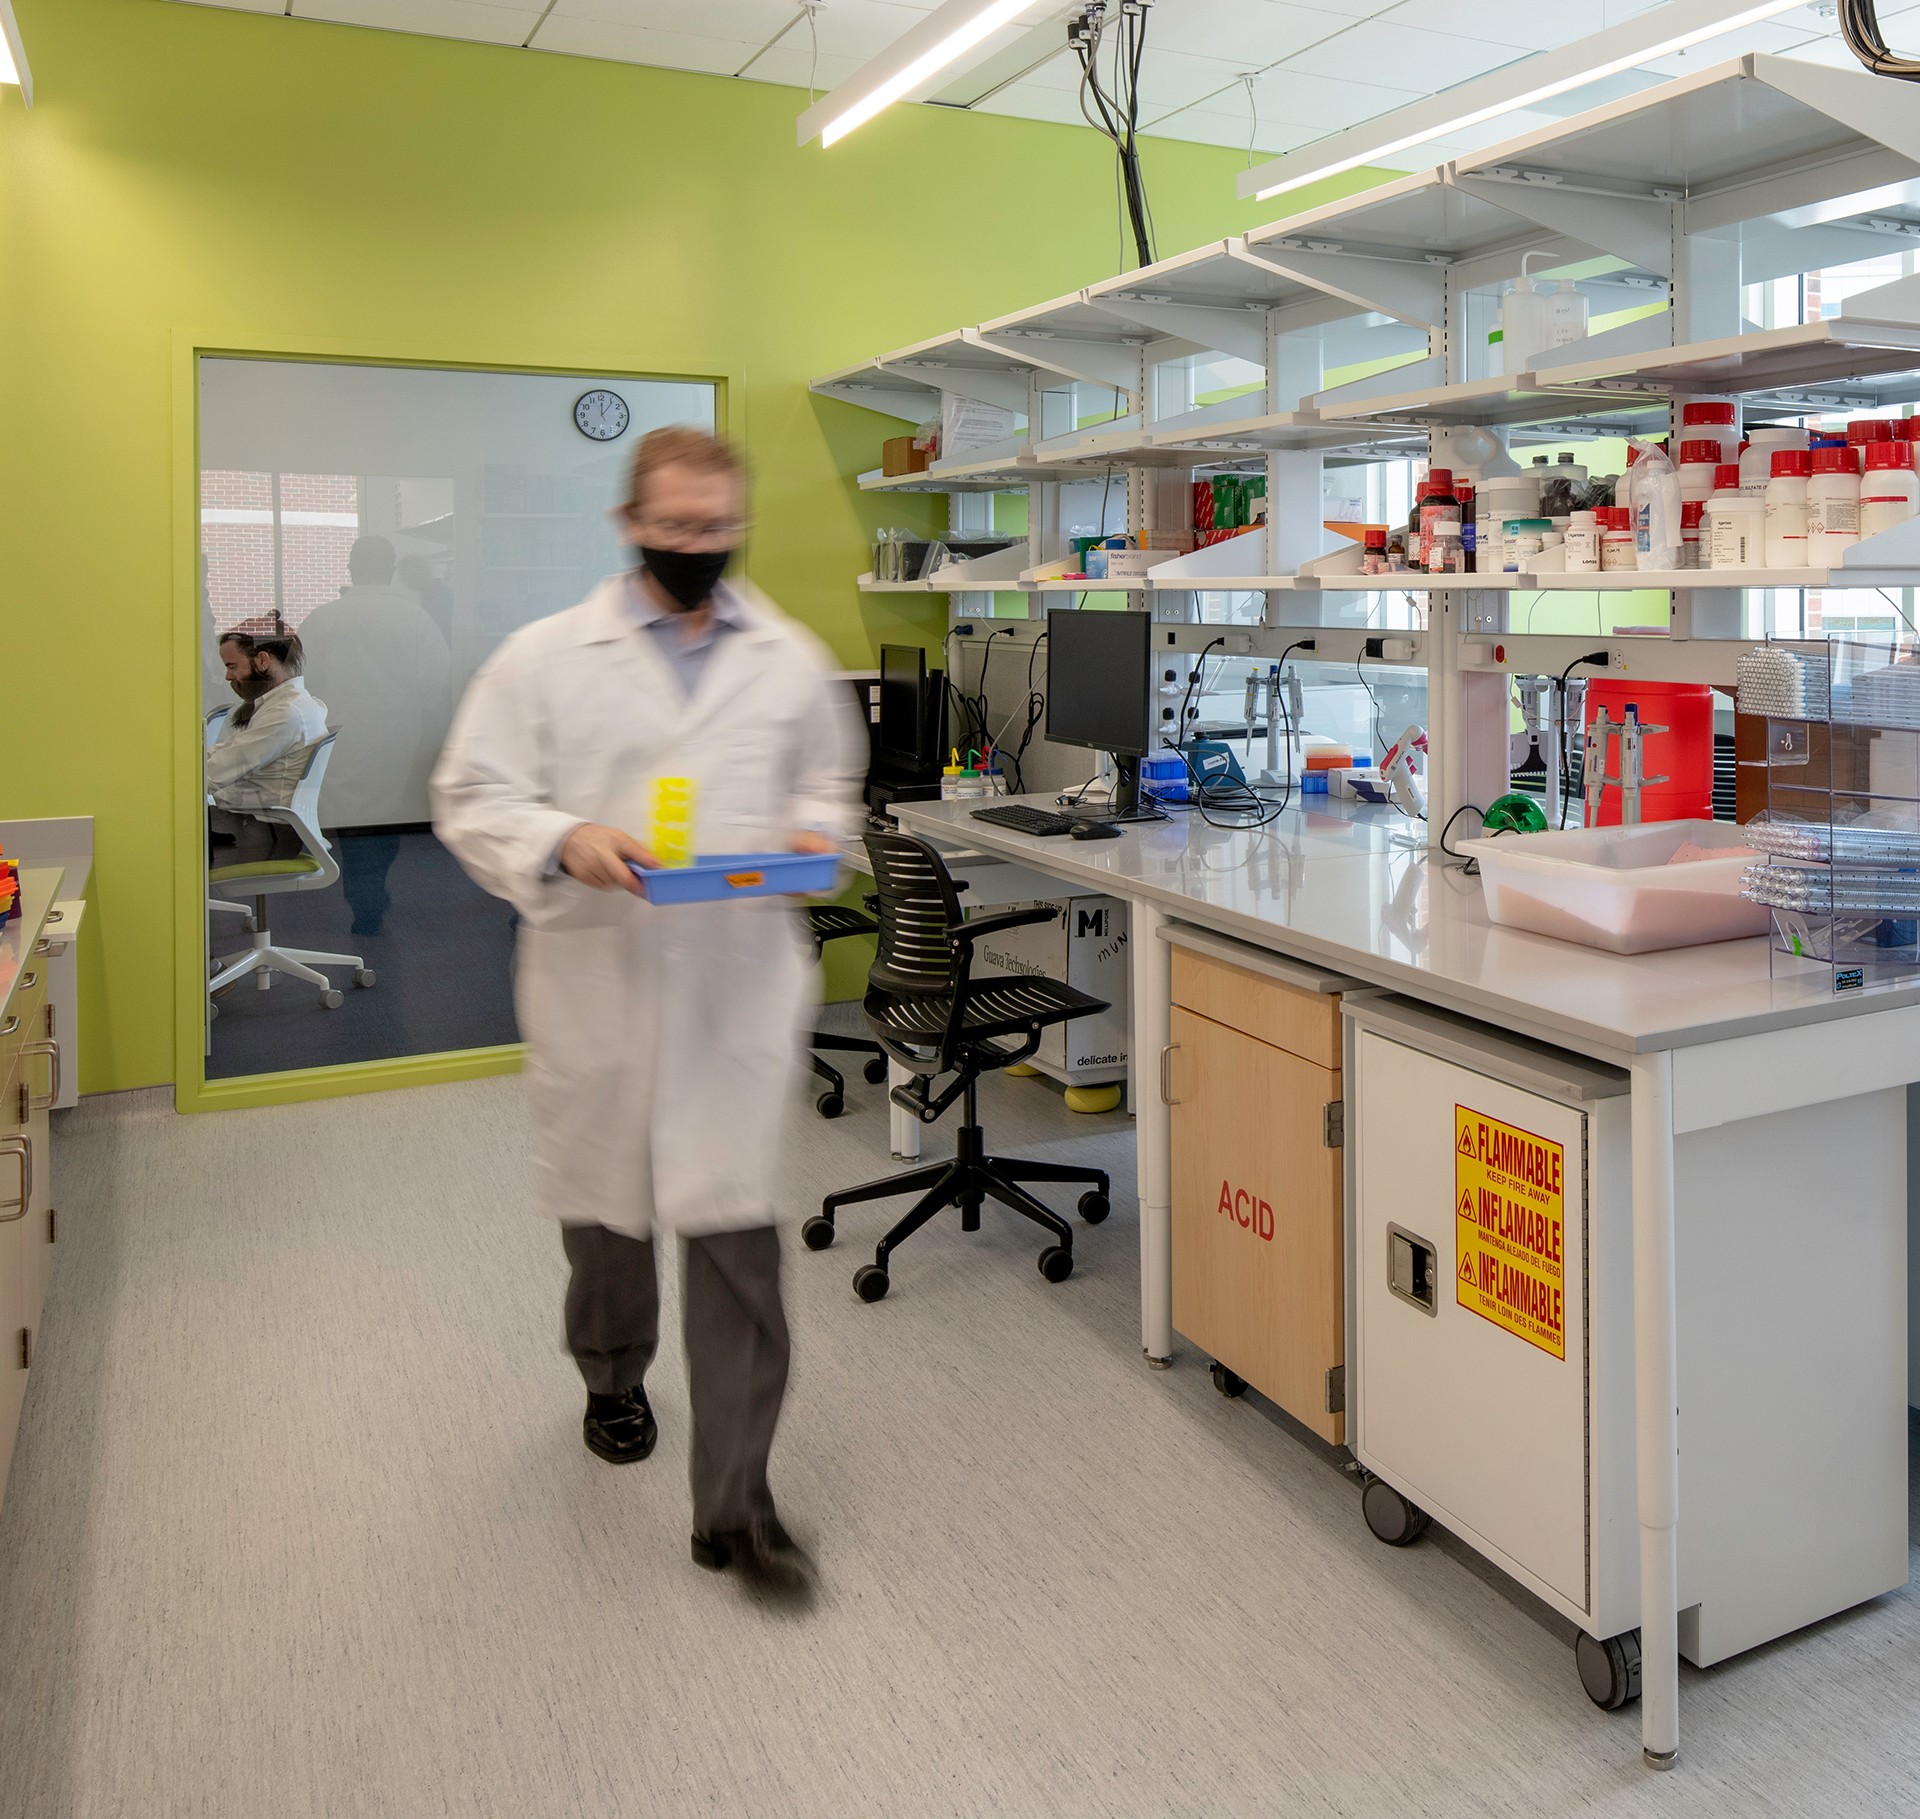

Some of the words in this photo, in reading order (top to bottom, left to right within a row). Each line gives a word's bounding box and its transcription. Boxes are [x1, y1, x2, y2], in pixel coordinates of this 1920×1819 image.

[1078, 909, 1103, 937] M
[984, 945, 1004, 968] Guava
[1077, 1054, 1118, 1066] delicate
[1478, 1123, 1560, 1195] FLAMMABLE
[1218, 1180, 1274, 1241] ACID
[1486, 1169, 1506, 1186] KEEP
[1508, 1179, 1526, 1195] FIRE
[1528, 1187, 1550, 1206] AWAY
[1478, 1187, 1560, 1264] INFLAMABLE
[1478, 1230, 1506, 1251] MANTENGA
[1506, 1241, 1530, 1263] ALEJADO
[1530, 1252, 1541, 1268] DEL
[1542, 1258, 1560, 1278] FUEGO
[1478, 1250, 1561, 1332] INFLAMMABLE
[1478, 1294, 1497, 1311] TENIR
[1498, 1303, 1512, 1320] LOIN
[1514, 1311, 1527, 1327] DES
[1528, 1318, 1561, 1346] FLAMMES
